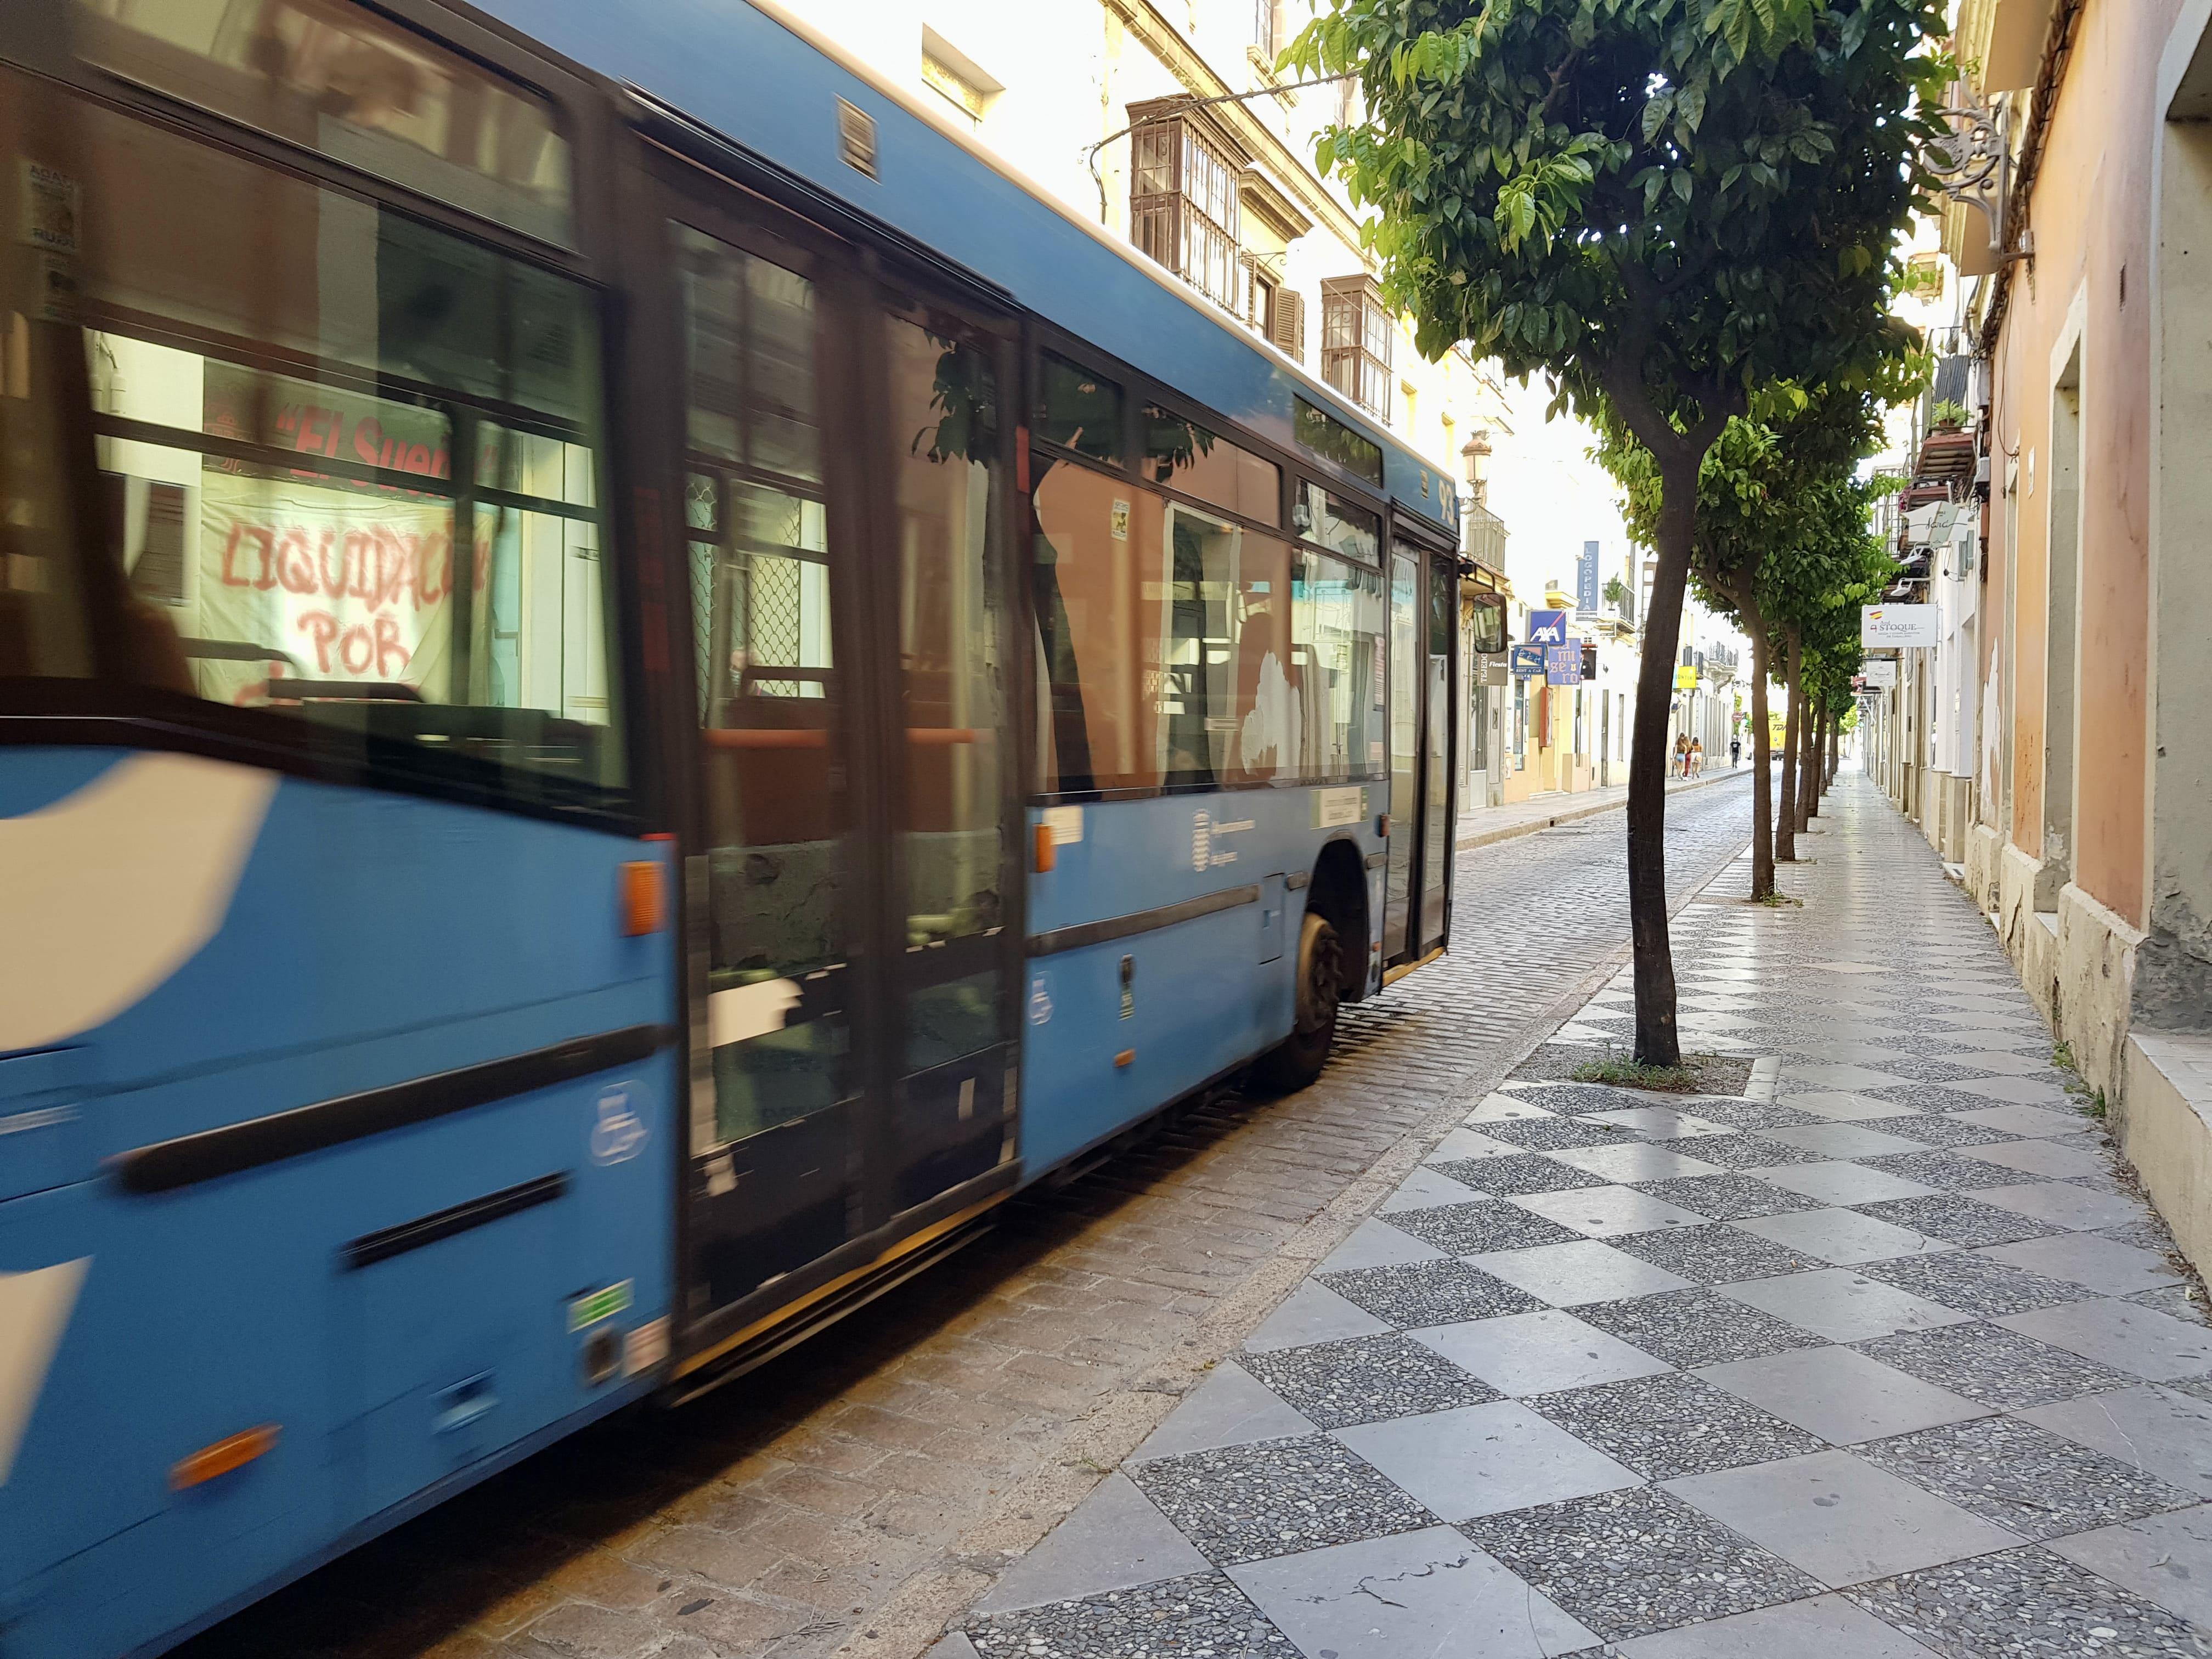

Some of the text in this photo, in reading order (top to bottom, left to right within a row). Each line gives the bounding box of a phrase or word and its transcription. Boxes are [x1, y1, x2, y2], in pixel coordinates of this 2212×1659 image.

[349, 416, 497, 499] Sue”
[1438, 479, 1454, 526] 93
[222, 521, 489, 612] LIQUIDAC
[1583, 548, 1593, 610] LOGOPEDIA
[297, 608, 411, 677] POR
[1530, 627, 1560, 641] AXA
[1880, 624, 1917, 632] STOQUE
[1562, 673, 1578, 684] ro
